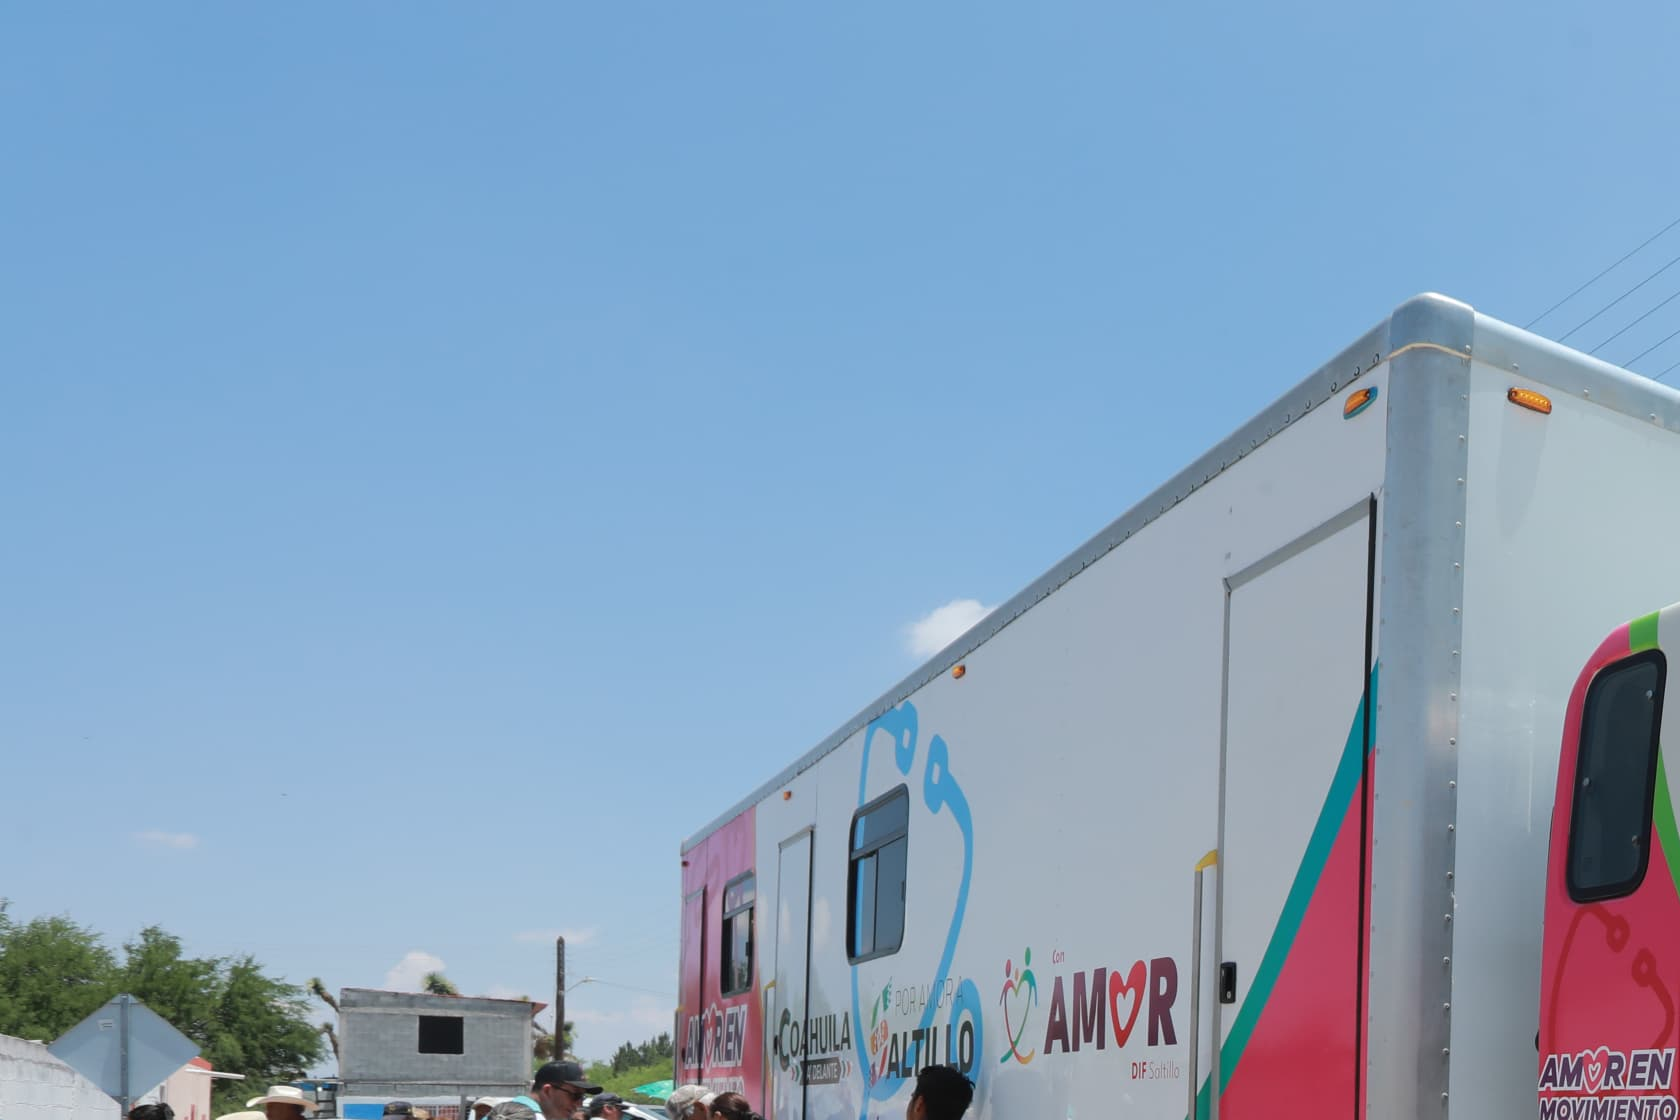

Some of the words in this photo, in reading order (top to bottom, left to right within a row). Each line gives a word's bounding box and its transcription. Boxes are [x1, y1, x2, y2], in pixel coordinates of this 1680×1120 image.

[1053, 949, 1065, 964] Con
[895, 986, 916, 1016] POR
[1043, 957, 1178, 1055] AMOR
[778, 1008, 851, 1072] COAHUILA
[1132, 1061, 1147, 1080] DIF
[1149, 1060, 1180, 1080] Saltillo
[1538, 1046, 1625, 1094] AMOR
[1626, 1048, 1676, 1089] EN
